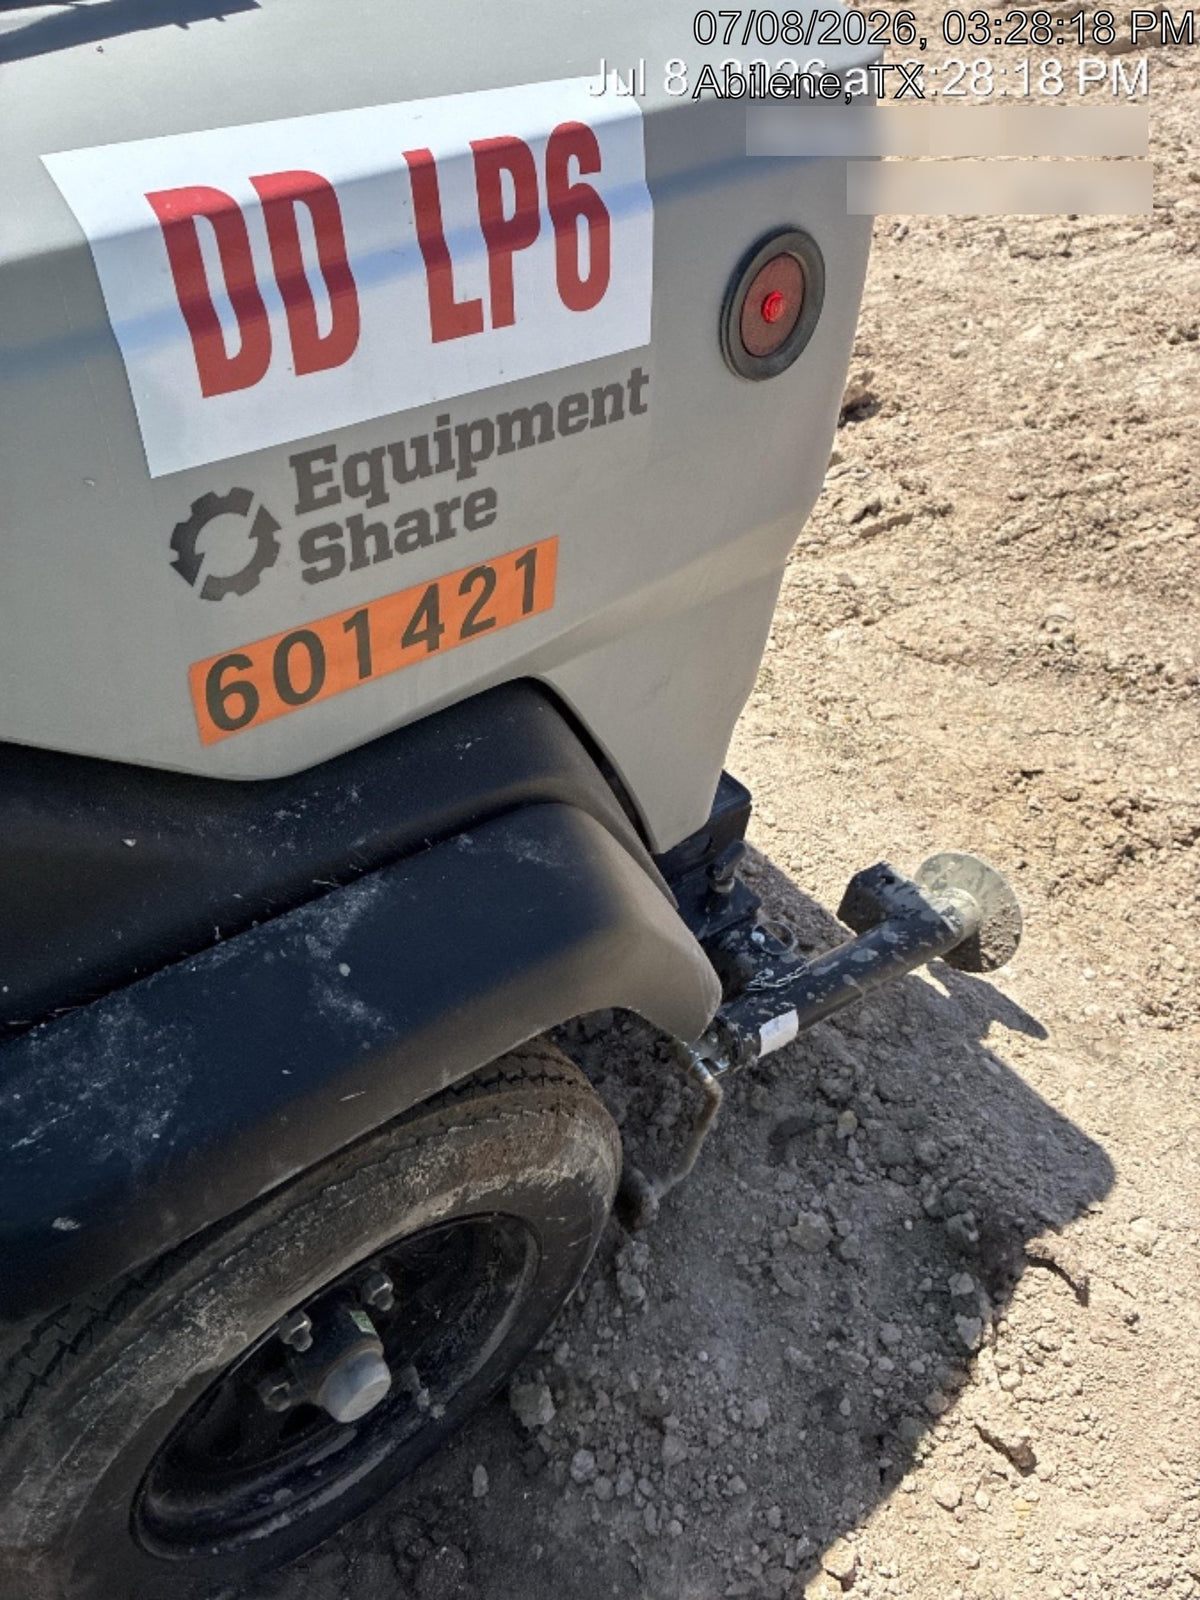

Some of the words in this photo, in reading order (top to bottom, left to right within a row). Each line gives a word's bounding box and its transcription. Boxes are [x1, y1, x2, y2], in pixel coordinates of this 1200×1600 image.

[144, 170, 361, 399] DD
[403, 121, 611, 343] LP6
[289, 366, 650, 516] Equipment
[299, 486, 498, 586] Share
[204, 547, 540, 732] 601421
